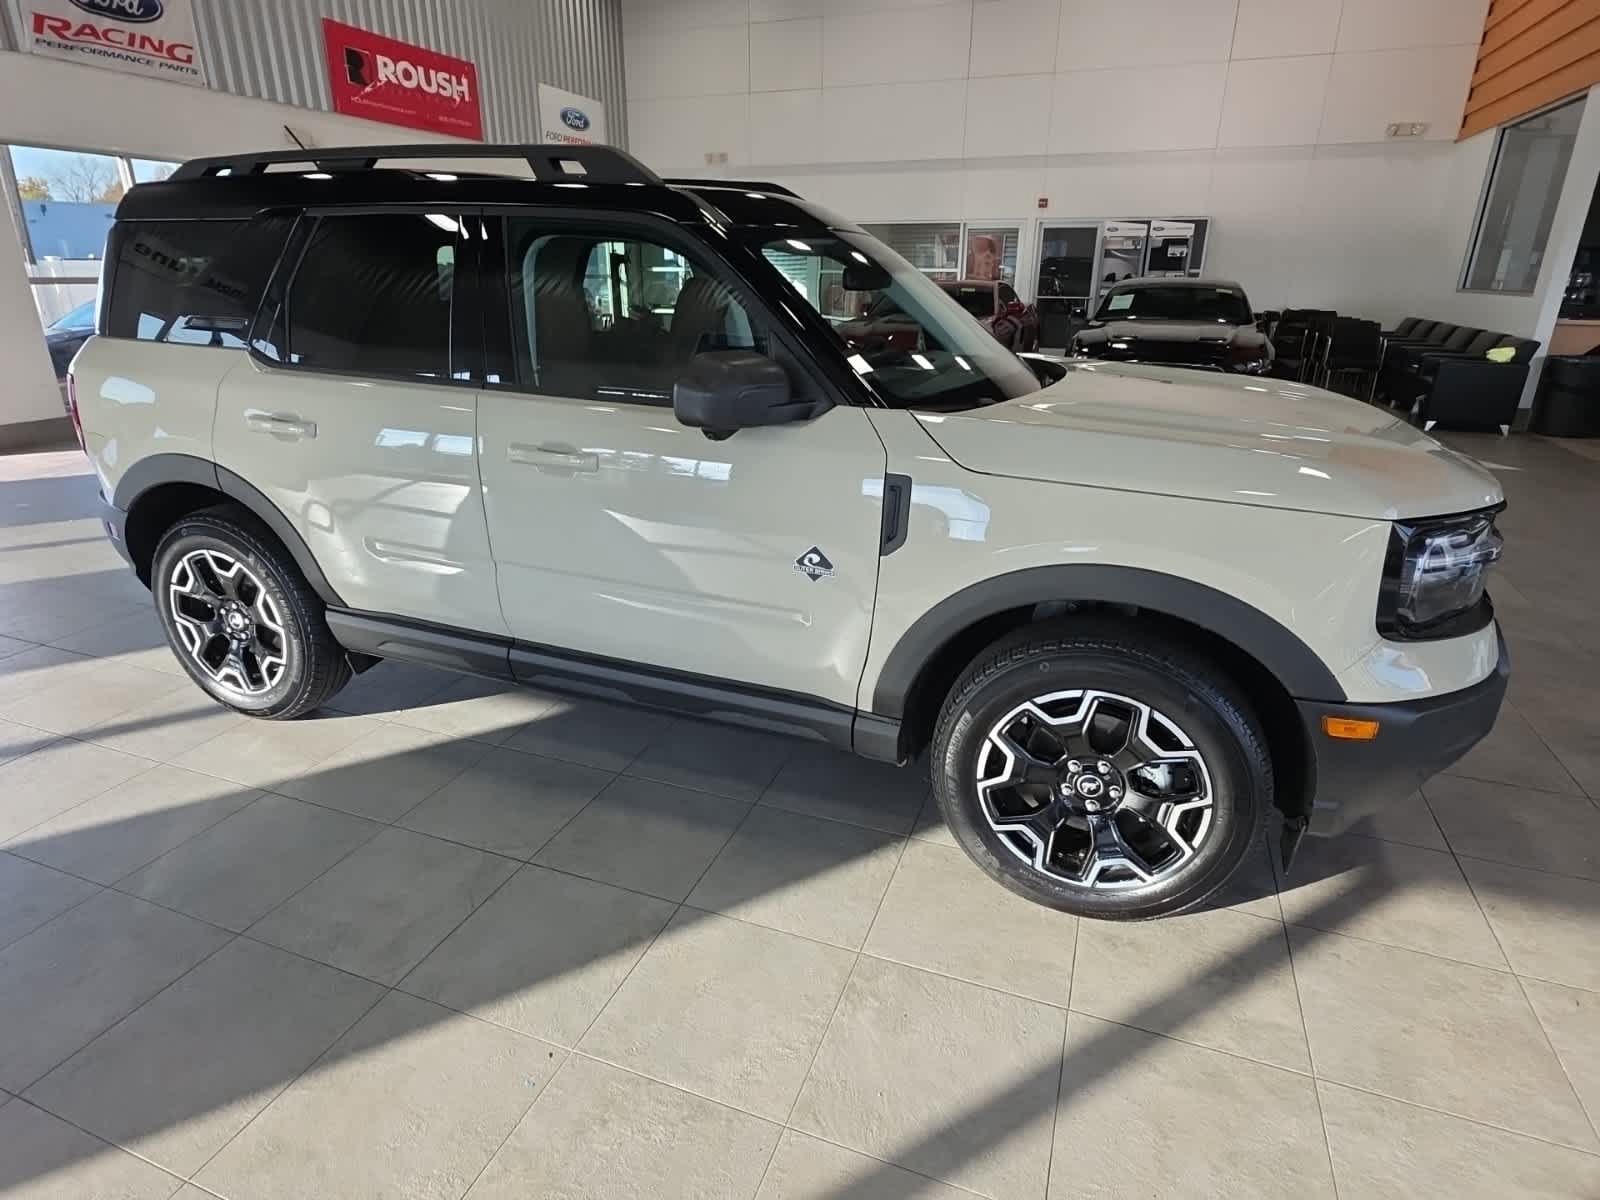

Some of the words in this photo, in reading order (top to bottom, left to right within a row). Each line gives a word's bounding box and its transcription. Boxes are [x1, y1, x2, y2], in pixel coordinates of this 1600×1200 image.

[32, 12, 193, 64] RACING
[35, 38, 157, 68] PERFORMANCE
[159, 62, 199, 76] PARTS
[376, 54, 470, 102] ROUSH
[546, 130, 563, 142] FORD
[566, 111, 585, 128] Ford
